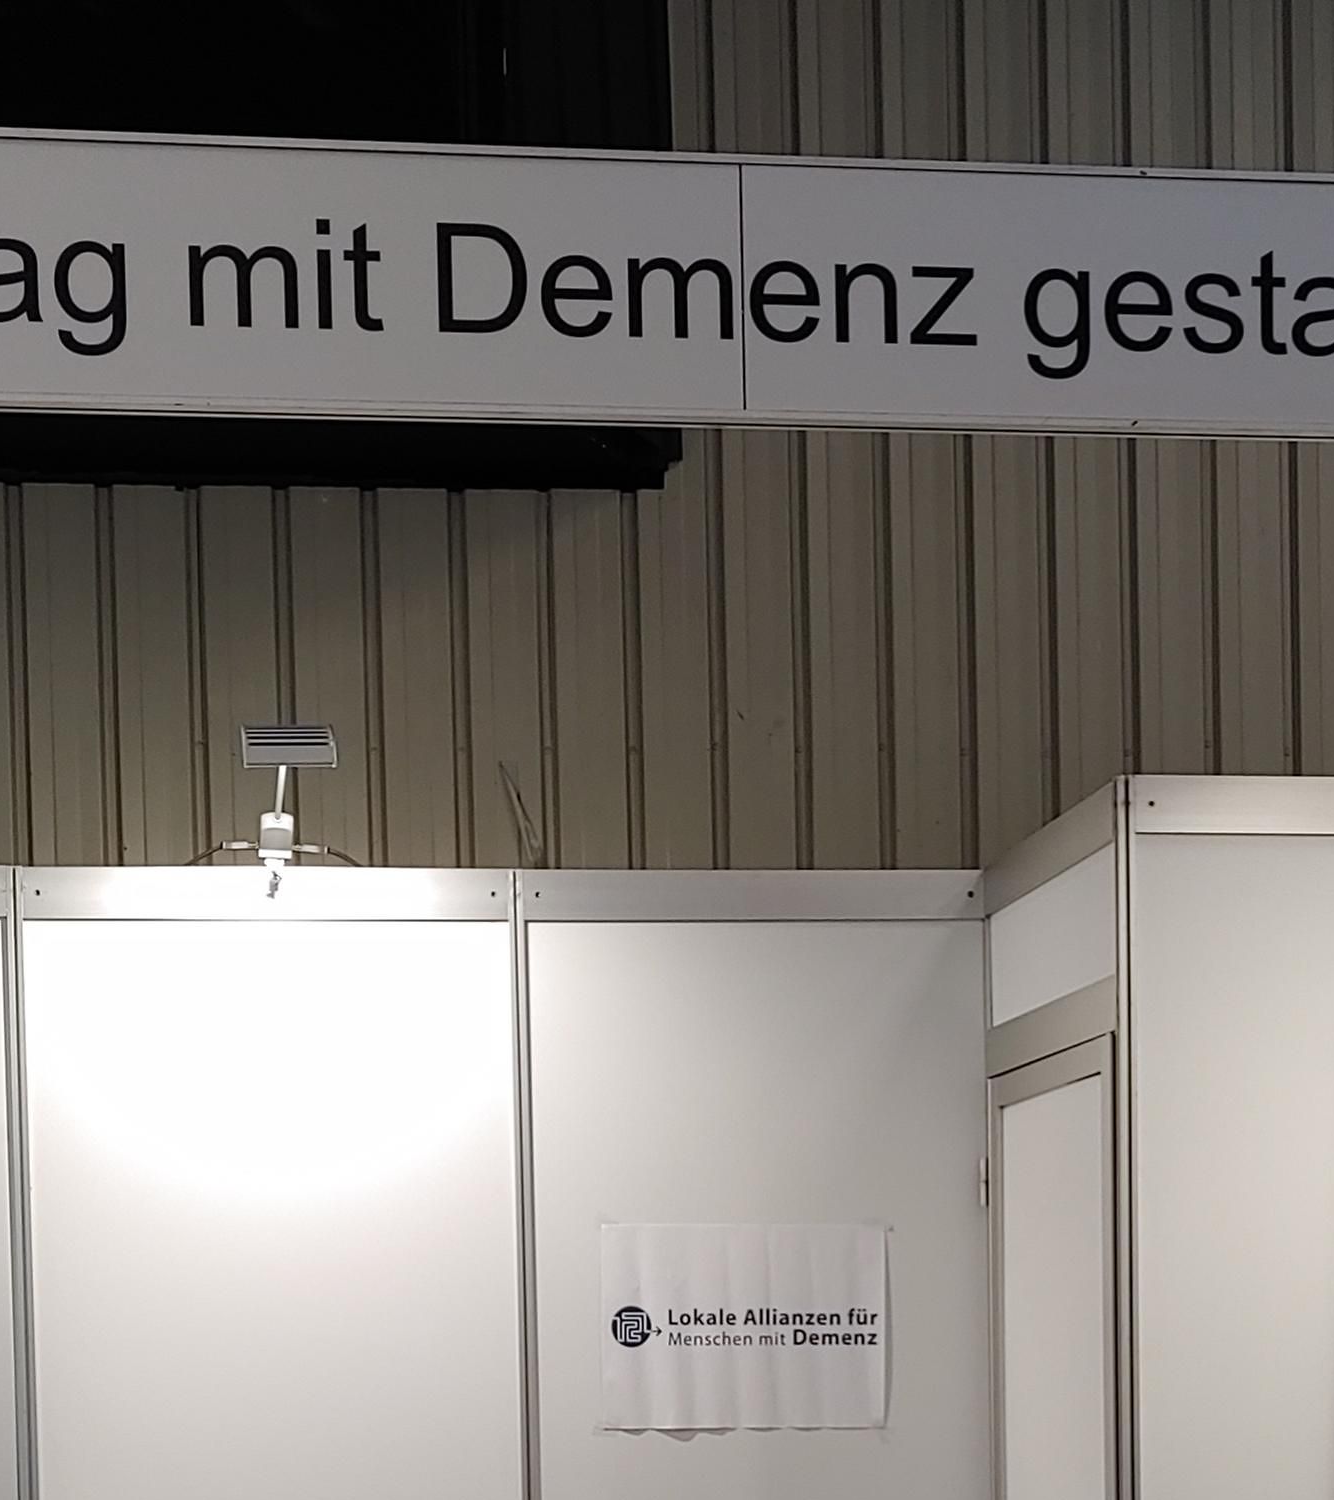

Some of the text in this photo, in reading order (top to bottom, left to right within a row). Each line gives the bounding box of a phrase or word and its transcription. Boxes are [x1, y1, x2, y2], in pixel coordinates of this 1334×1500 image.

[188, 219, 383, 332] mit
[436, 222, 978, 346] Demenz
[668, 1308, 878, 1326] Lokale Allianzen für
[668, 1329, 878, 1346] Menschen mit Demenz
